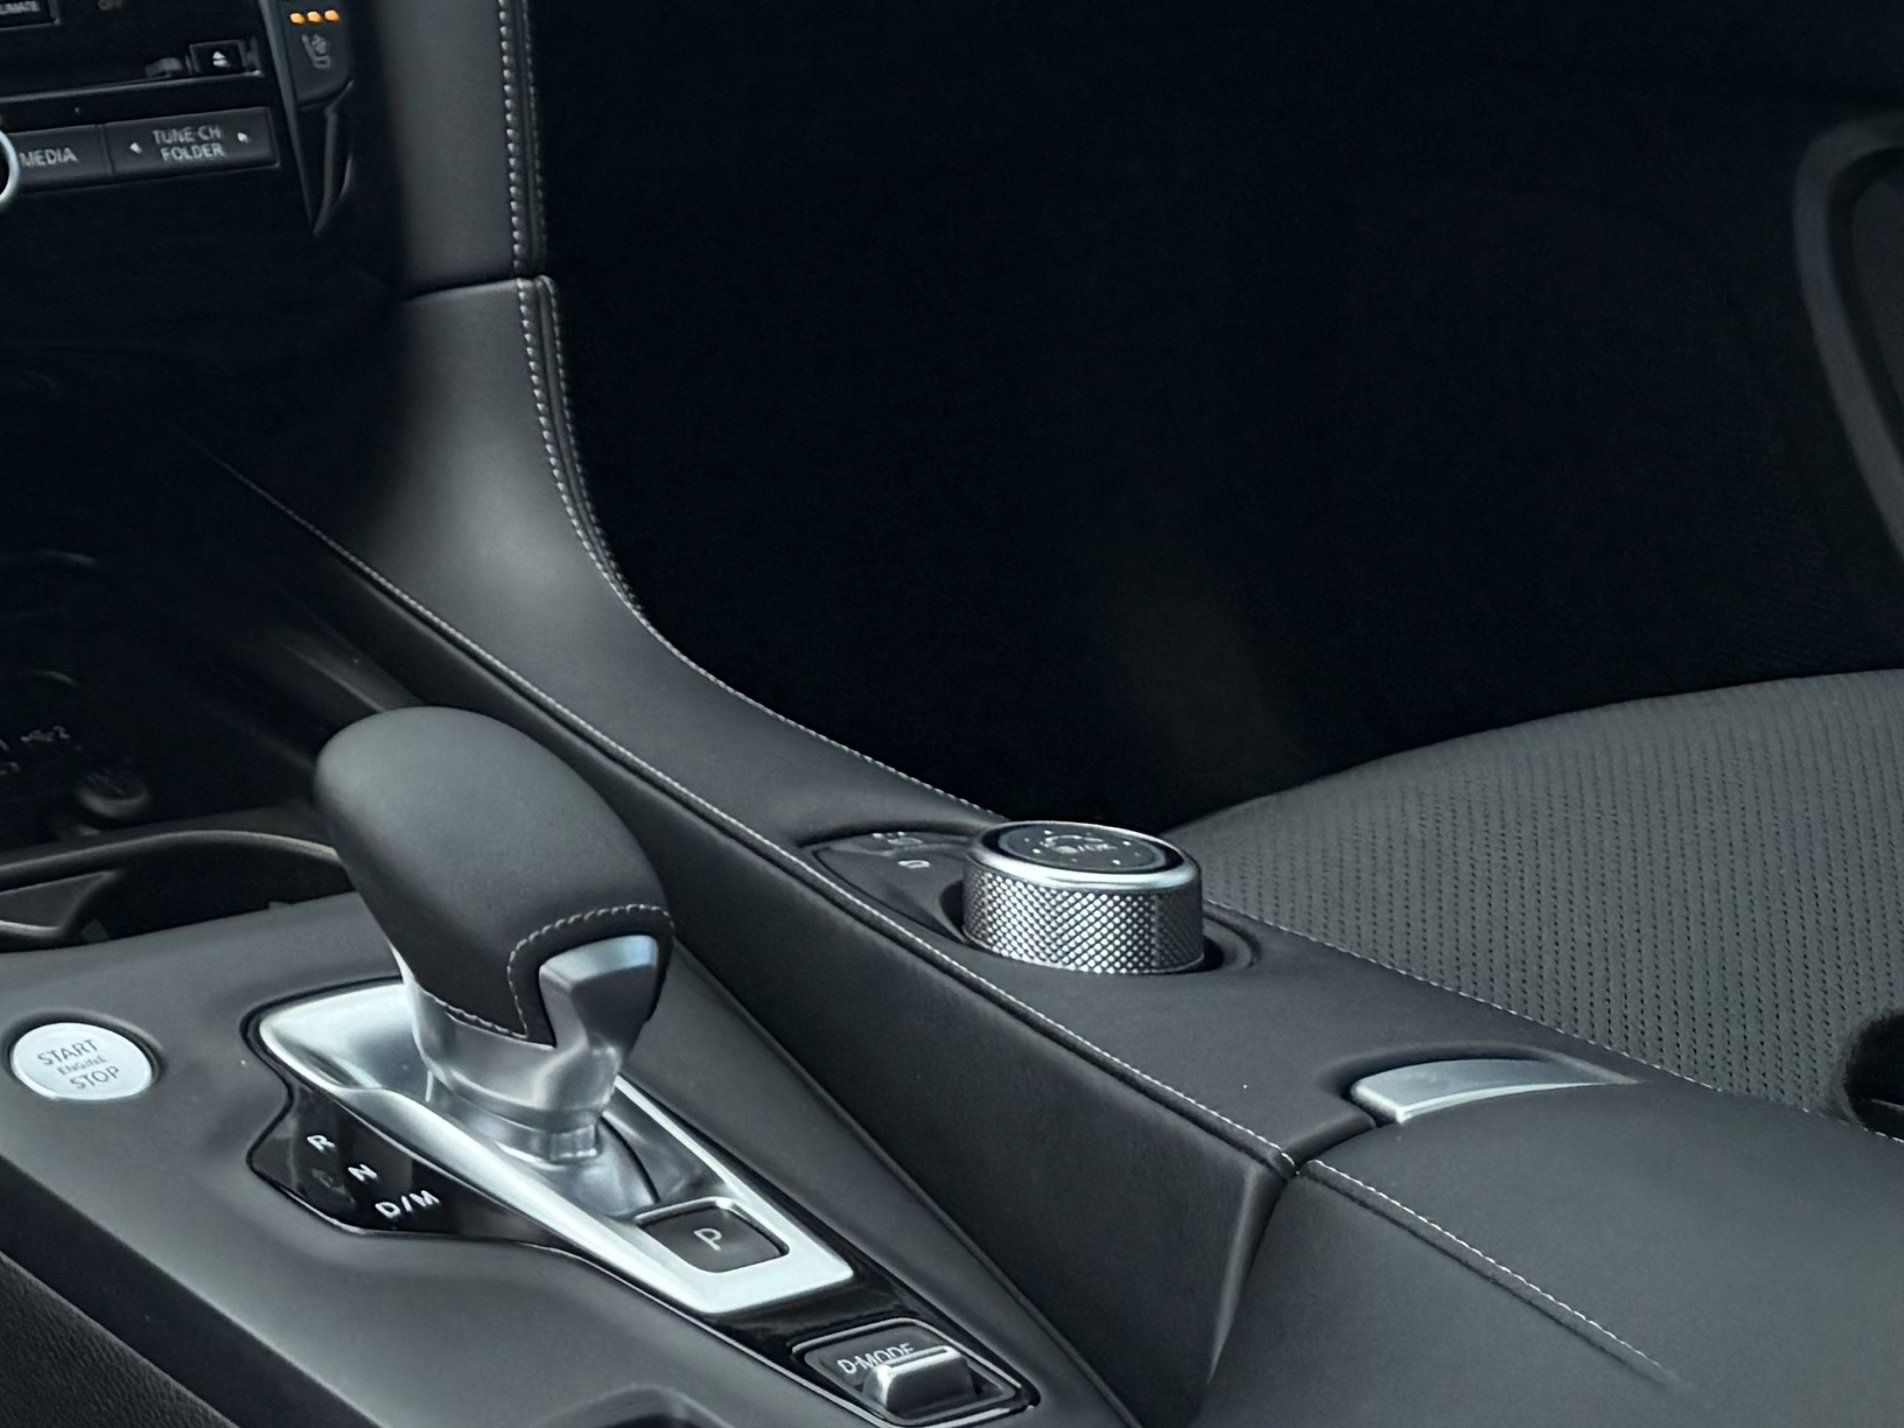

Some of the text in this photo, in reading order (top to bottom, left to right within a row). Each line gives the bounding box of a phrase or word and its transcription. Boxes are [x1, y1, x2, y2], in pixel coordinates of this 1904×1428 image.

[19, 147, 80, 168] MEDIA
[159, 142, 224, 163] FOLDER
[36, 1038, 99, 1067] START
[68, 1064, 121, 1090] STOP
[306, 1134, 338, 1154] R
[347, 1164, 380, 1183] N
[374, 1189, 441, 1220] D/M
[693, 1227, 723, 1251] P
